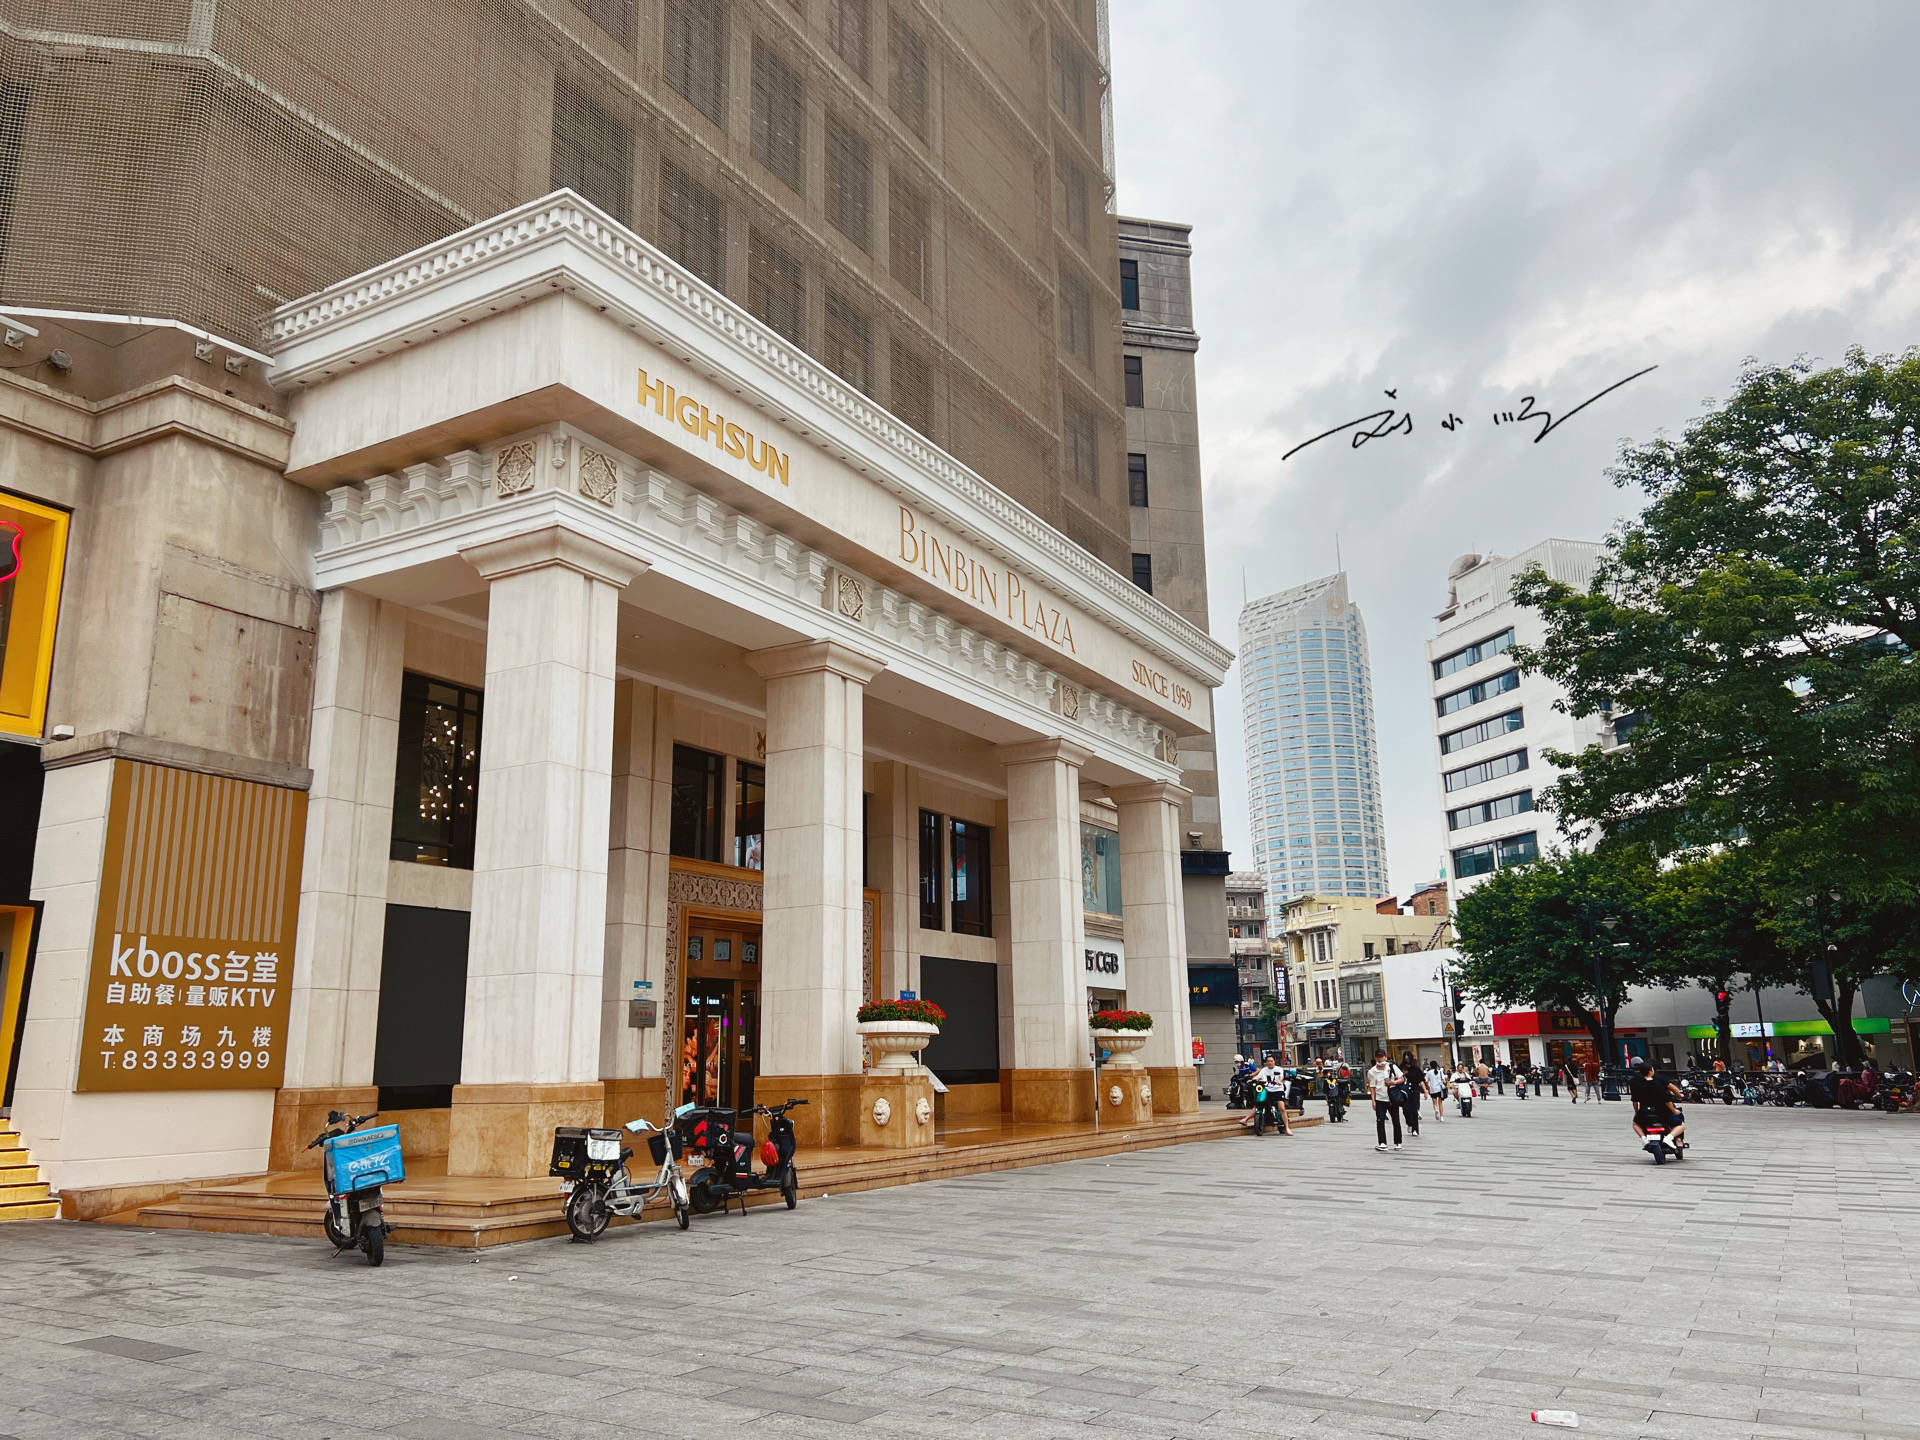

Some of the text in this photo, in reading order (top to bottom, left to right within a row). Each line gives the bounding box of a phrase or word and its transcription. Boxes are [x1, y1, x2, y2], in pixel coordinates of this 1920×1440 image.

[637, 367, 790, 488] HIGHSUN
[898, 504, 1077, 655] BINBIN PLAZA
[1131, 659, 1192, 711] SINCE 1959
[1096, 950, 1119, 975] CGB
[102, 1023, 272, 1048] 本商场九楼
